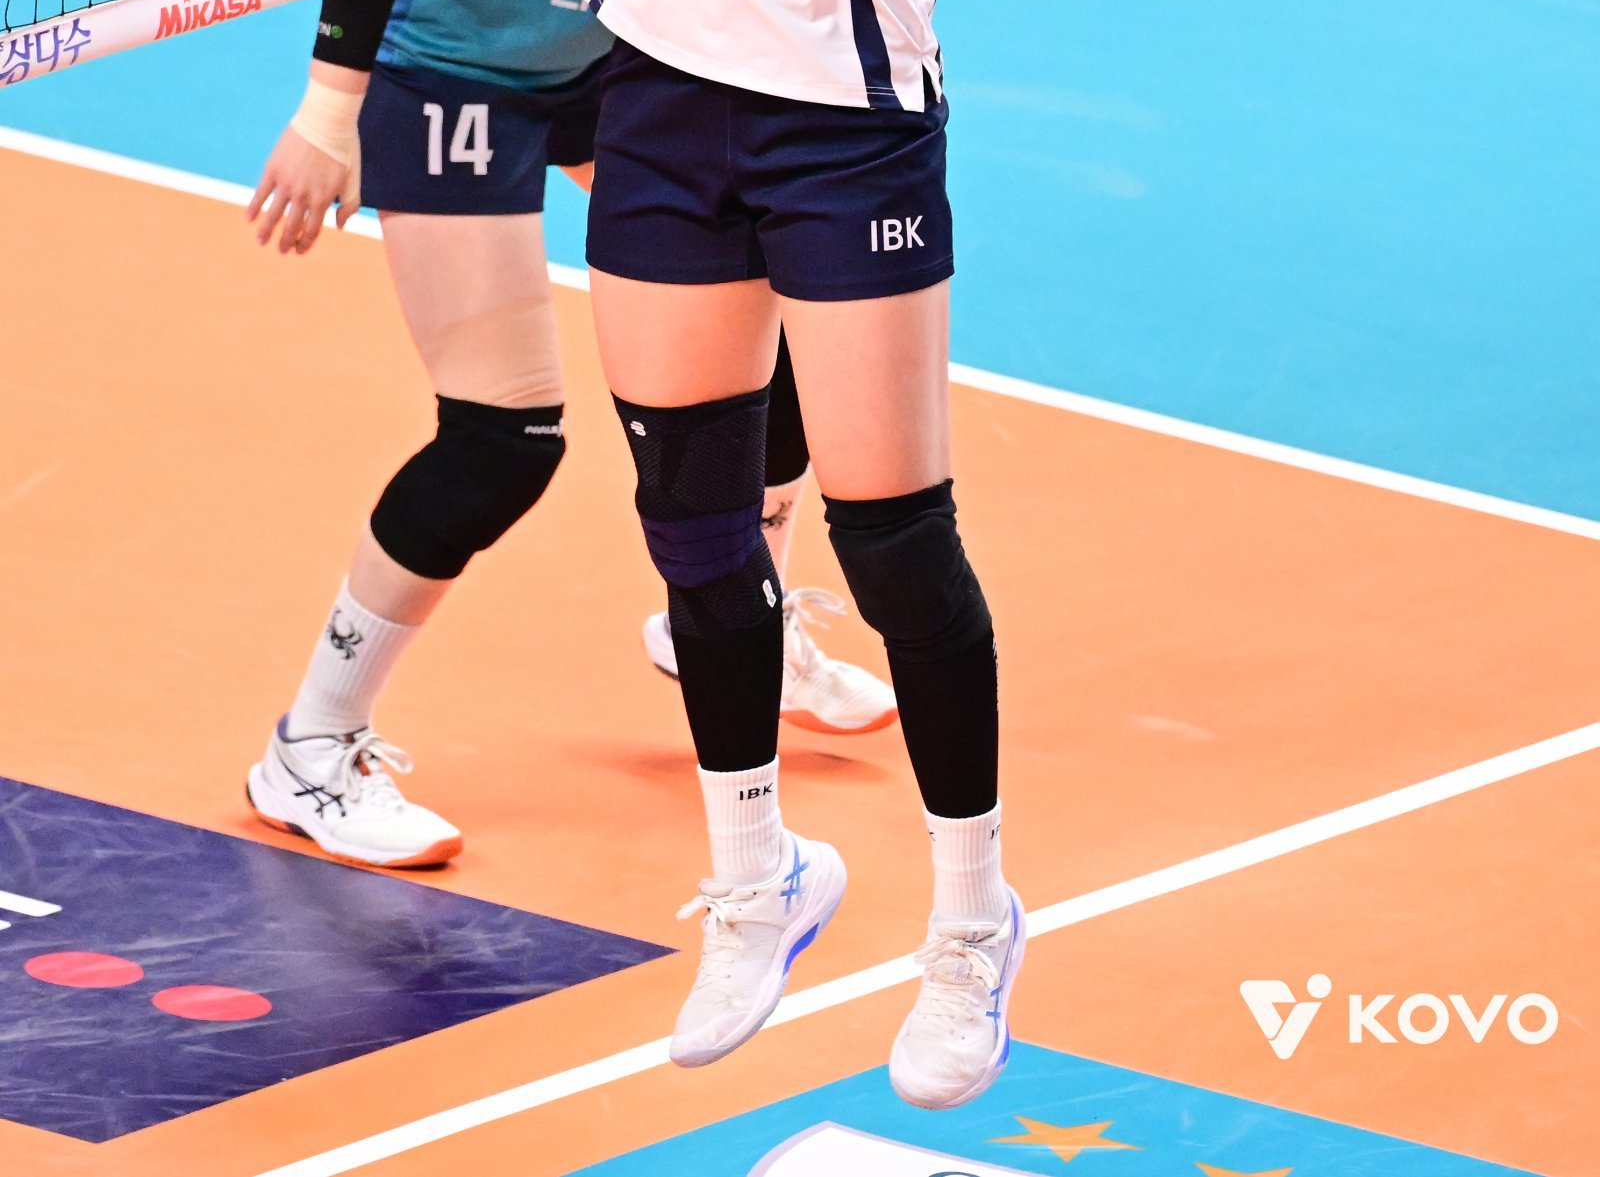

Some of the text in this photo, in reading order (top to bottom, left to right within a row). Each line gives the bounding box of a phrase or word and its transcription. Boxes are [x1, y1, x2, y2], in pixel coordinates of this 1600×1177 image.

[423, 102, 494, 176] 14
[870, 215, 925, 252] IBK
[739, 782, 773, 801] IBK
